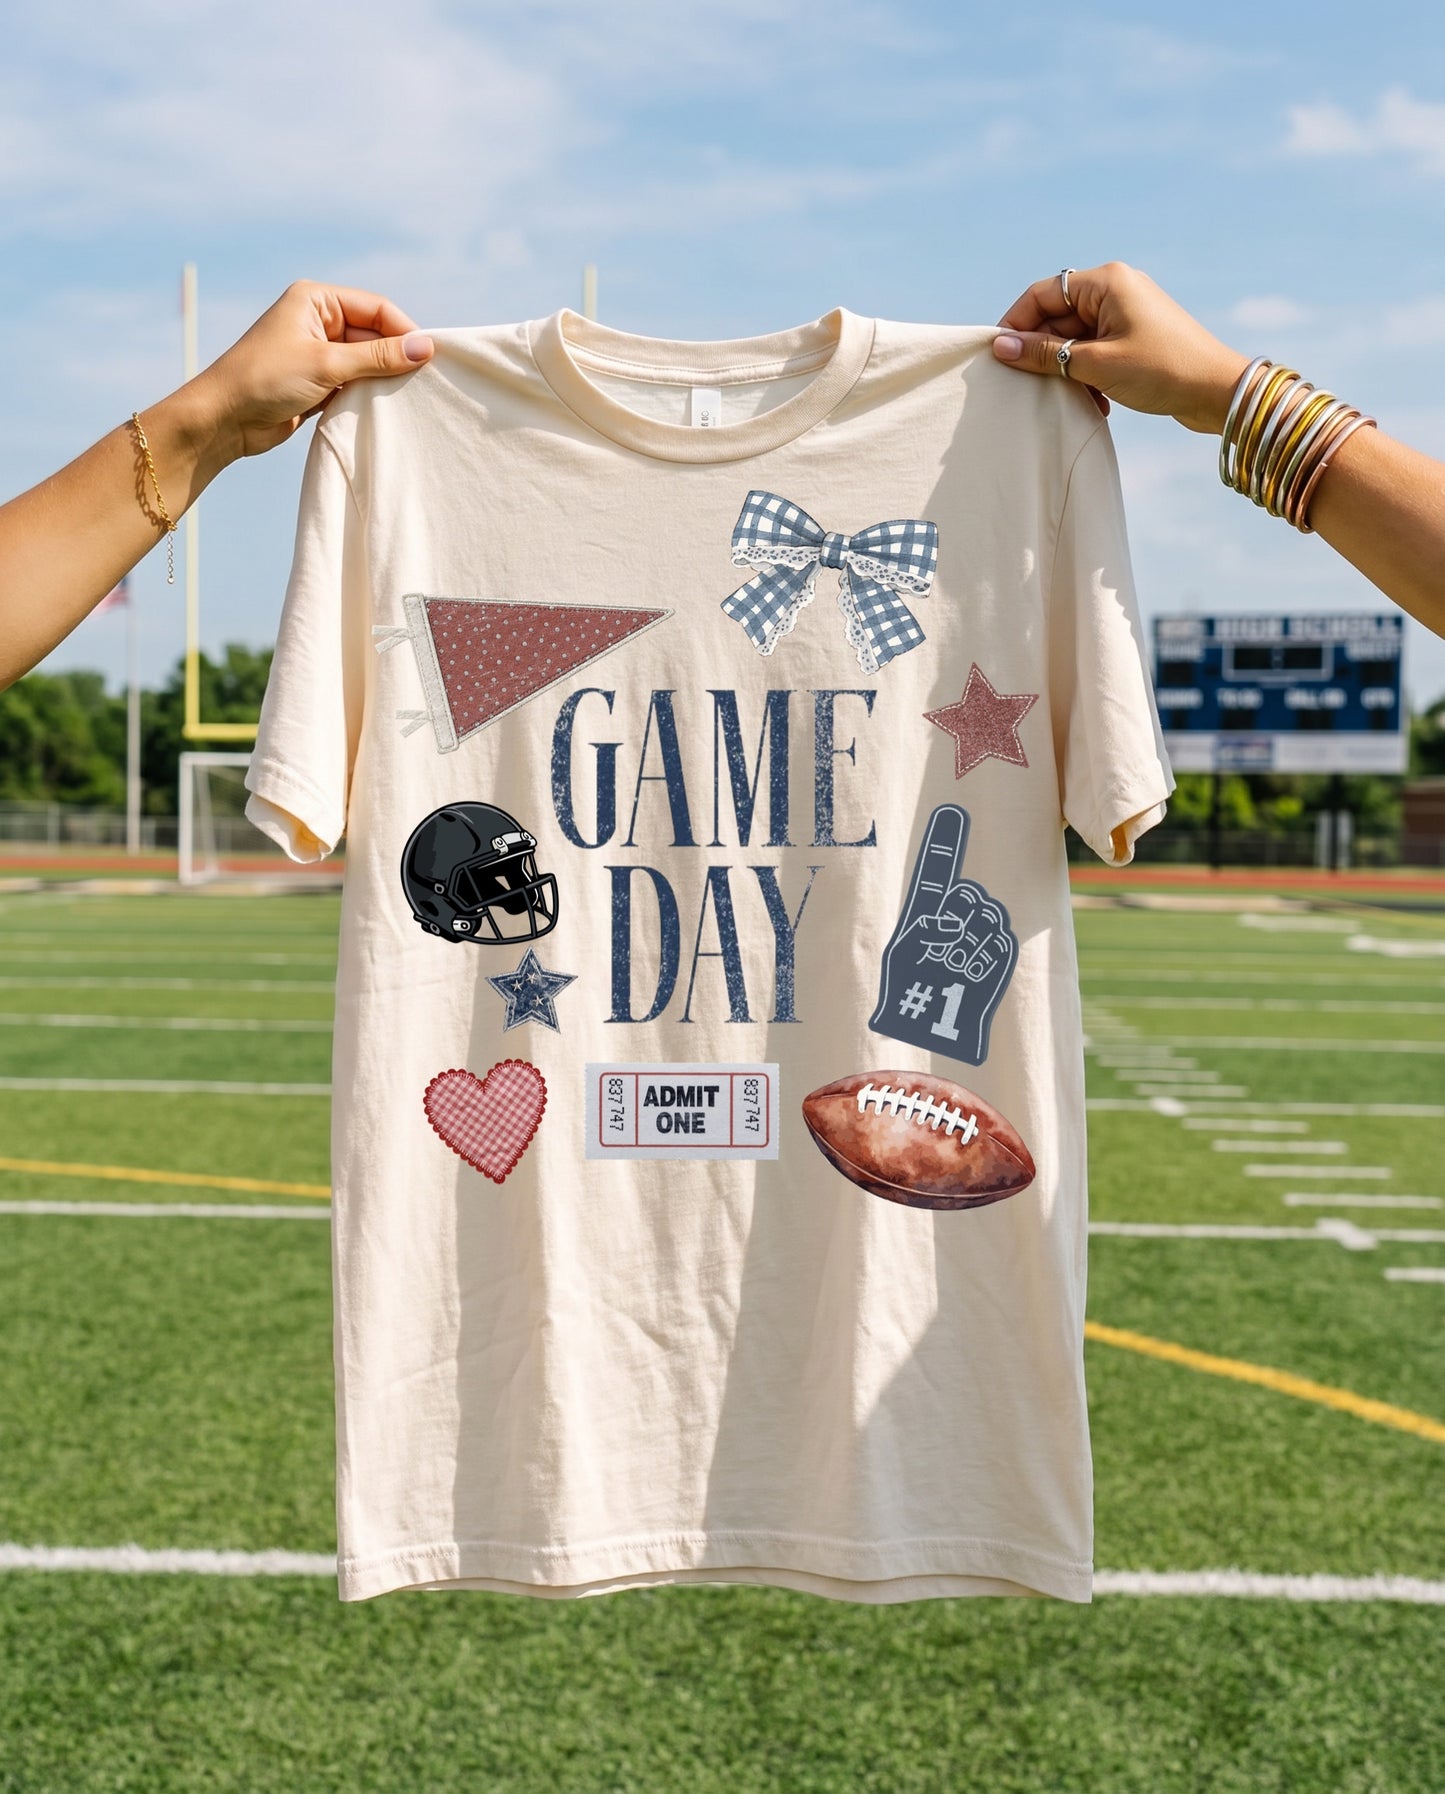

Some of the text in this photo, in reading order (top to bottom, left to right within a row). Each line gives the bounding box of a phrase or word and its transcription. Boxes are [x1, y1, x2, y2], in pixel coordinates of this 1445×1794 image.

[551, 688, 878, 849] GAME
[603, 866, 825, 1023] DAY
[899, 981, 966, 1041] #1
[643, 1085, 720, 1107] ADMIT
[656, 1112, 706, 1134] ONE
